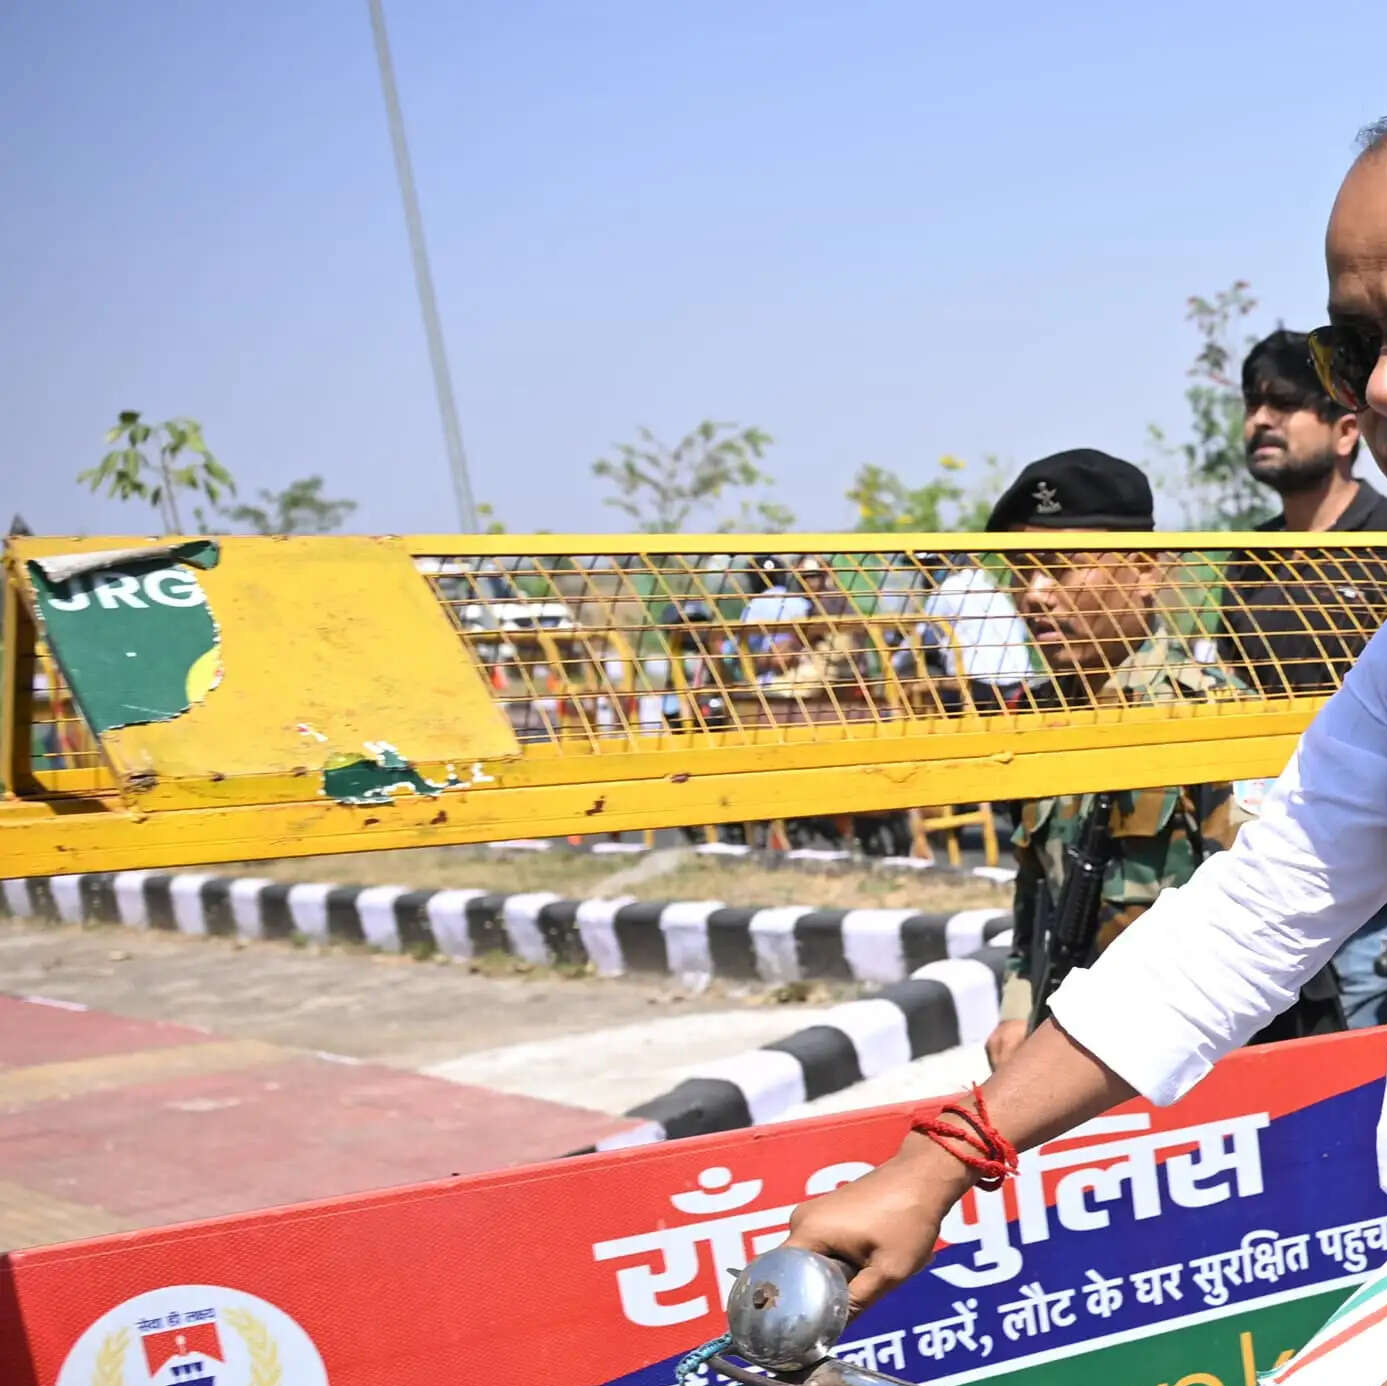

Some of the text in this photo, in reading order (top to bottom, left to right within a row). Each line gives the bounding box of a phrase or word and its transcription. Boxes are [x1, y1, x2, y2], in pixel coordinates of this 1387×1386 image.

[47, 566, 207, 612] JRG
[930, 1112, 1270, 1289] पुलिस
[911, 1297, 994, 1360] करें,
[998, 1282, 1077, 1341] लौट
[1083, 1269, 1124, 1319] के
[1129, 1264, 1184, 1306] घर
[1189, 1229, 1310, 1306] सुरक्षित
